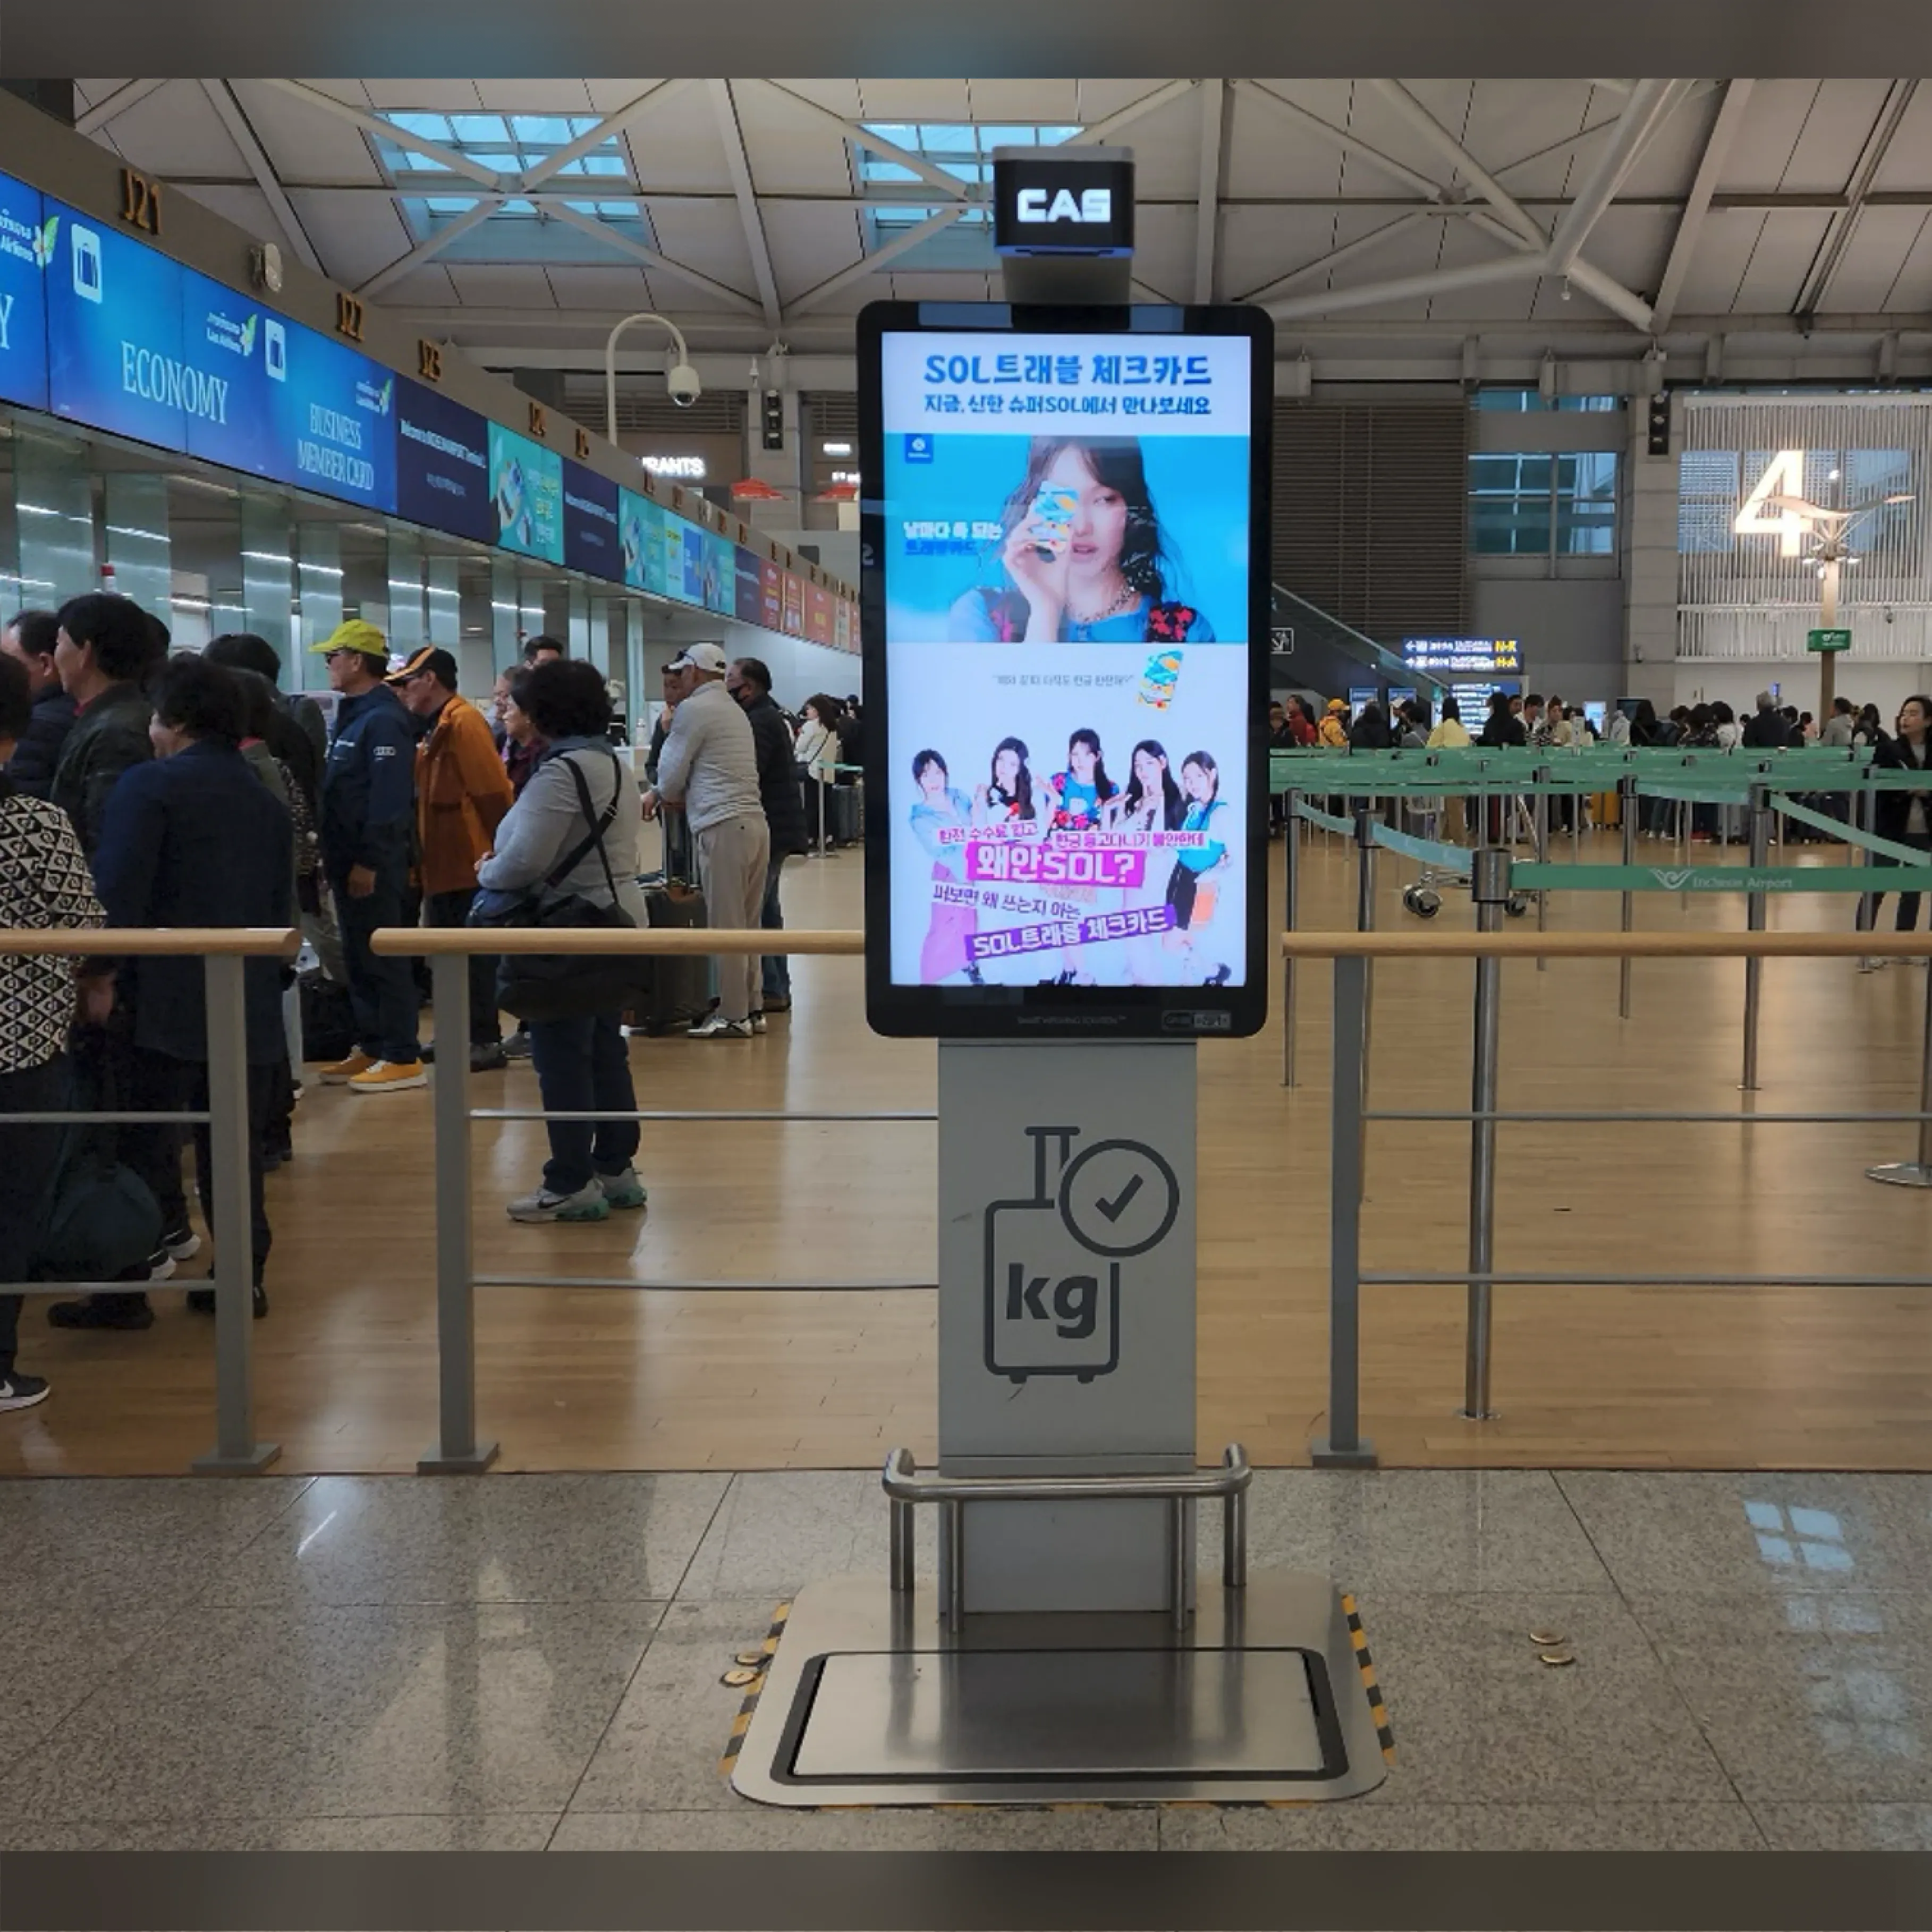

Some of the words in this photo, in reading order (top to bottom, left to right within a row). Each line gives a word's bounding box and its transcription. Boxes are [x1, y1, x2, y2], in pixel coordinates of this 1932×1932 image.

[1017, 189, 1111, 223] CAS
[121, 340, 228, 425] ECONOMY
[924, 354, 1082, 384] SOL트래블
[1091, 355, 1211, 385] 체크카드
[968, 394, 1004, 414] 신한
[1009, 395, 1117, 414] 슈퍼SOL에서
[1123, 396, 1211, 414] 만나보세요
[310, 402, 361, 451] BUSINESS
[1735, 451, 1812, 557] 4
[1747, 877, 1792, 889] Airport
[1006, 1264, 1098, 1338] kg
